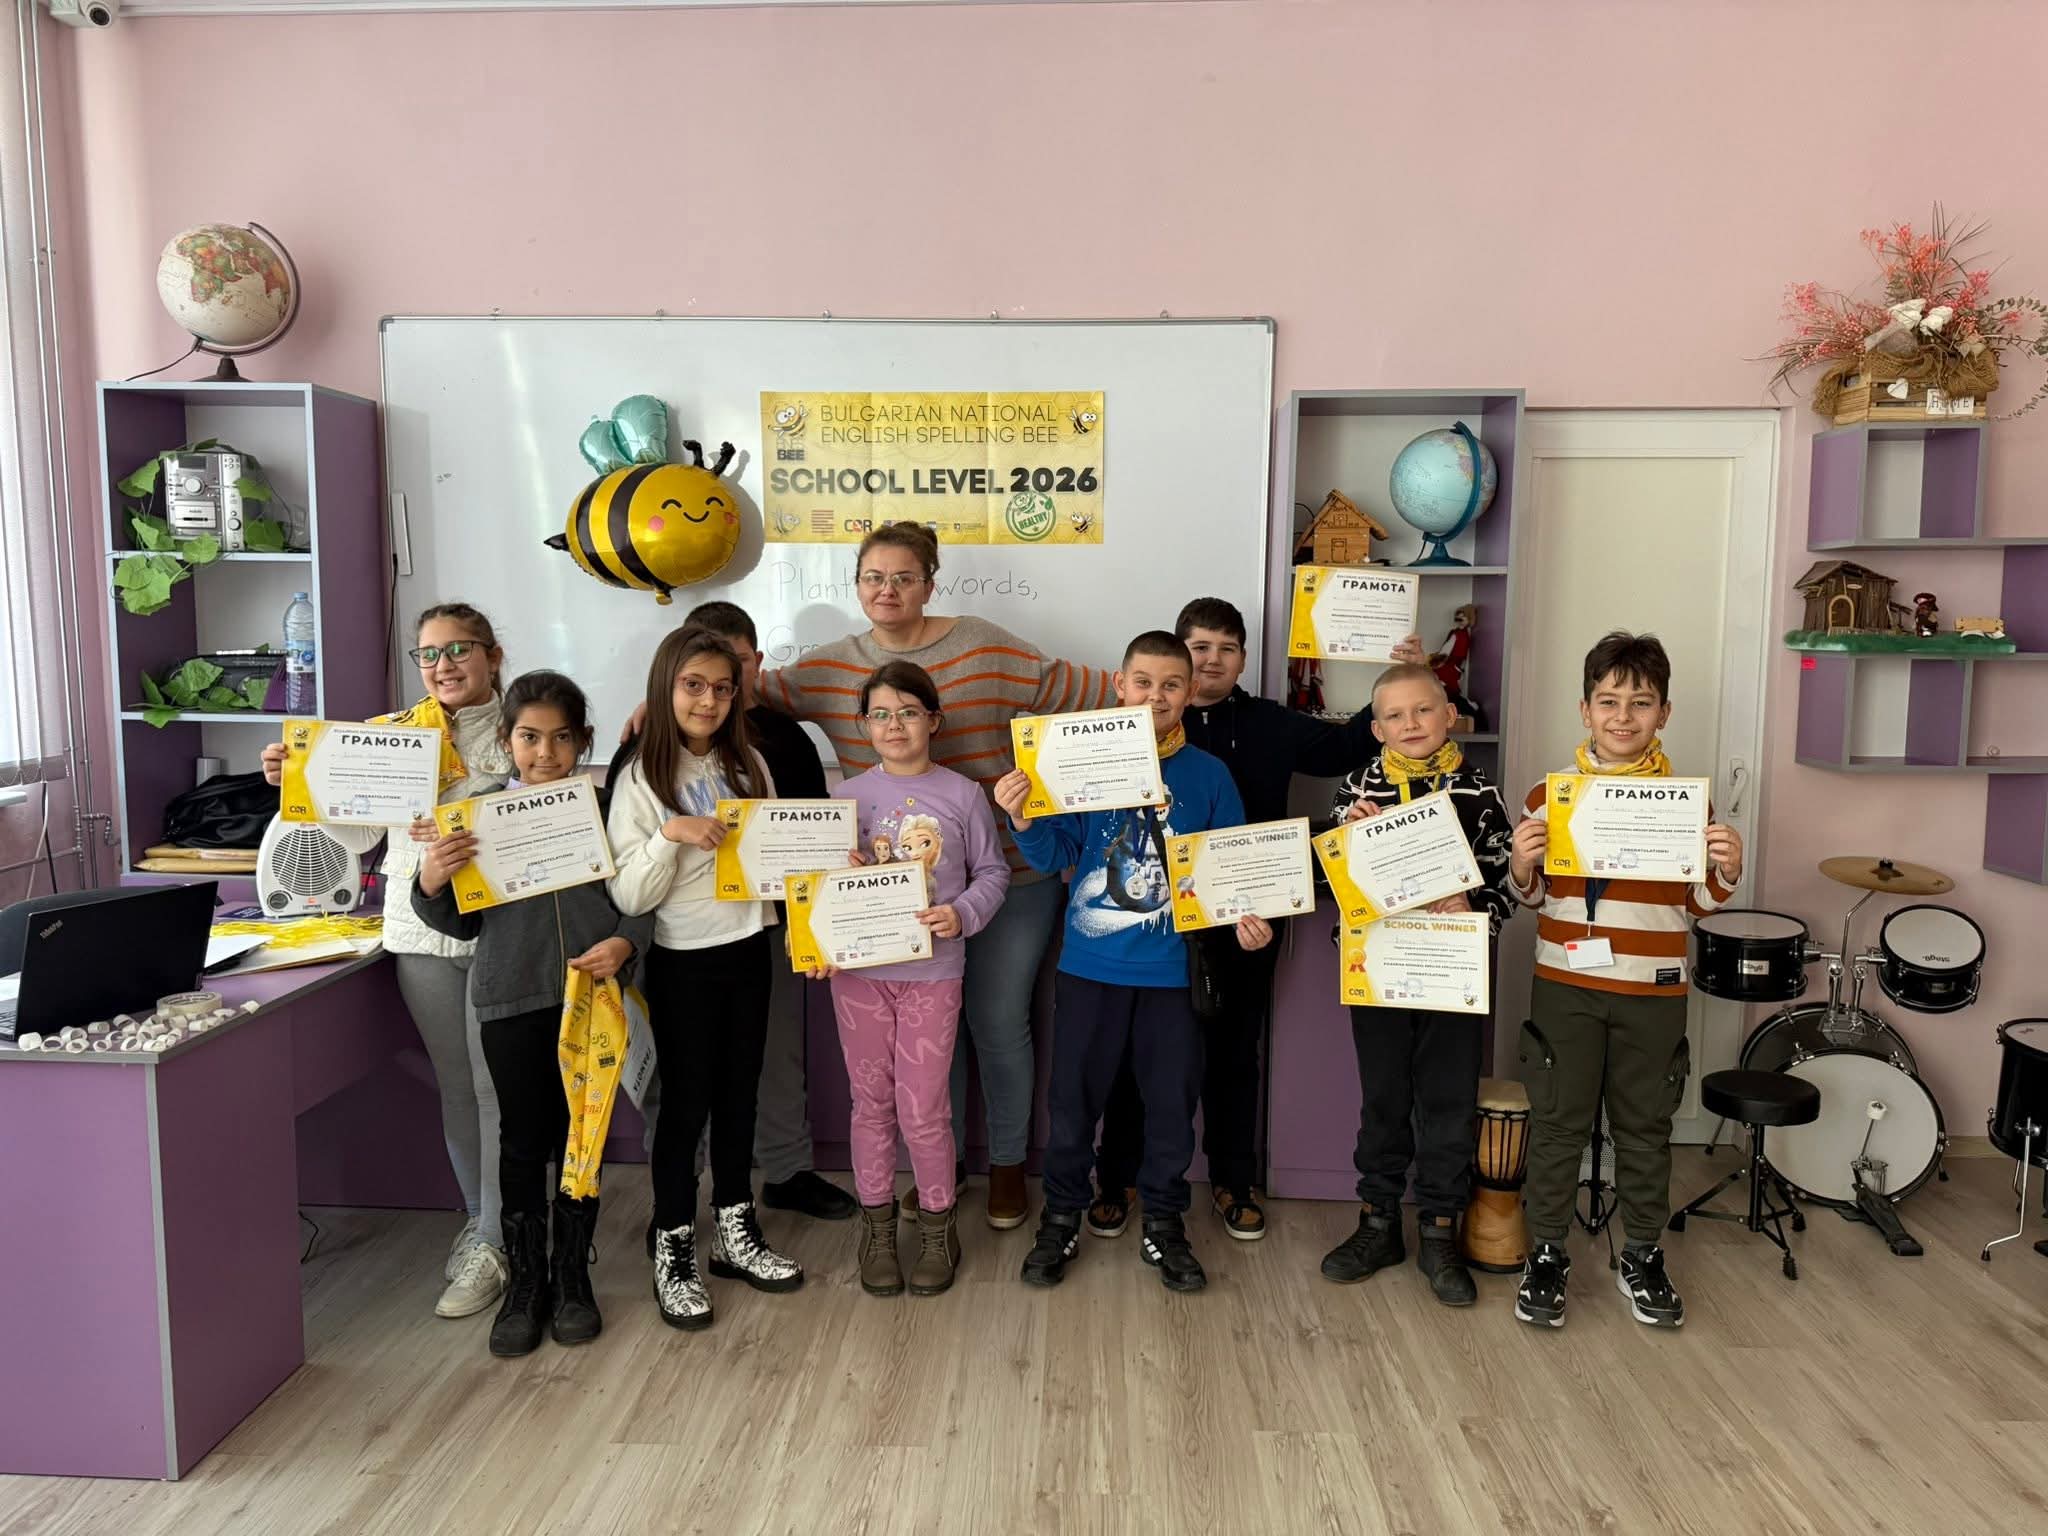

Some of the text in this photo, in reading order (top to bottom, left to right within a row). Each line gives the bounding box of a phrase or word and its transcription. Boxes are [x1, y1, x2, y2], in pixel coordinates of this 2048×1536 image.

[820, 404, 1056, 422] BULGARIAN NATIONAL
[821, 427, 908, 443] ENGLISH
[916, 427, 1015, 443] SPELLING
[1023, 427, 1058, 443] BEE
[777, 449, 805, 460] BEE
[770, 467, 1098, 494] SCHOOL LEVEL 2026
[935, 567, 1039, 601] words,
[1343, 580, 1406, 593] ГРАМОТА
[1063, 719, 1137, 736] ГРАМОТА
[342, 735, 423, 749] ГРАМОТА
[496, 790, 578, 816] ГРАМОТА
[1605, 789, 1689, 800] ГРАМОТА
[770, 811, 842, 821] ГРАМОТА
[1365, 807, 1439, 838] ГРАМОТА
[1209, 838, 1253, 851] SCHOOL
[1255, 831, 1299, 844] WINNER
[838, 874, 910, 891] ГРАМОТА
[1384, 920, 1477, 933] SCHOOL WINNER
